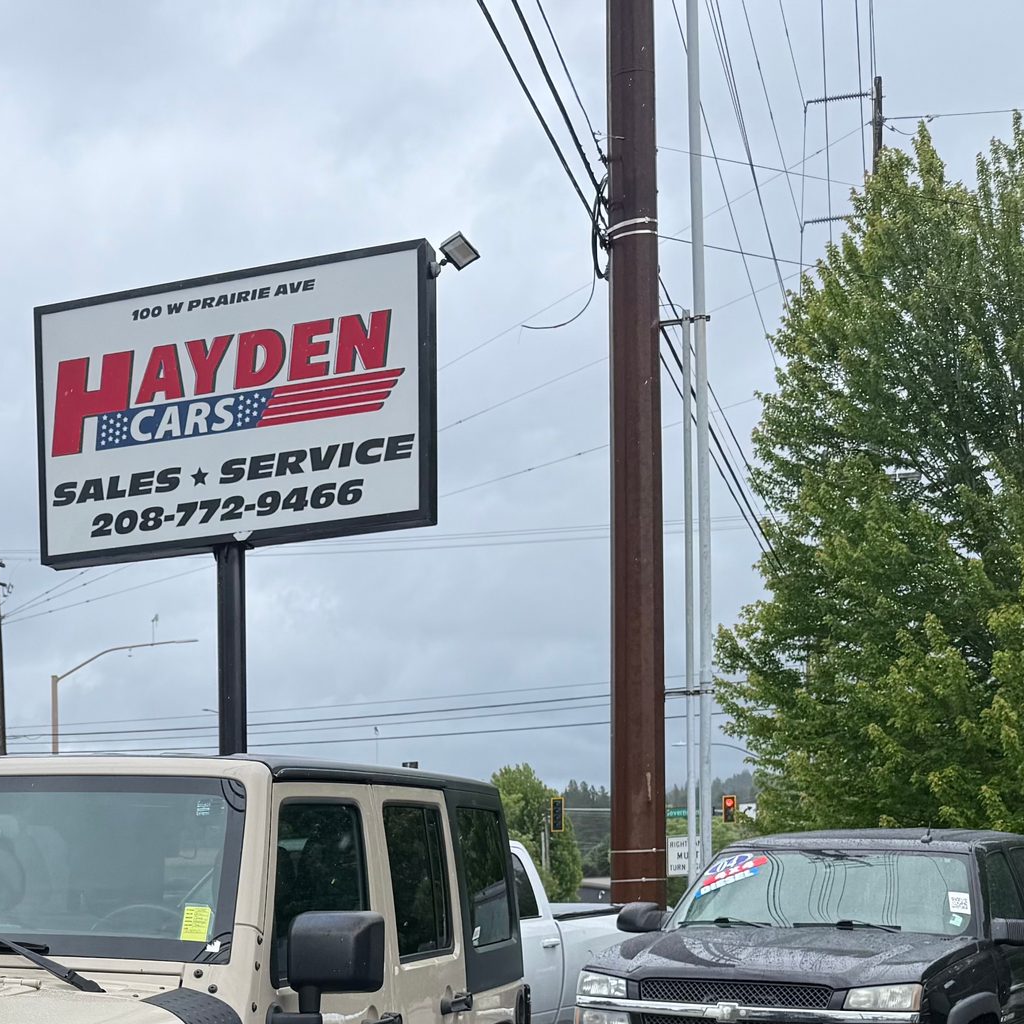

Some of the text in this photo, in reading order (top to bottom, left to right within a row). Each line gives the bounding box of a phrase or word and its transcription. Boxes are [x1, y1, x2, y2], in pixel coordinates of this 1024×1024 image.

[132, 279, 316, 321] 100 W PRAIRIE AVE
[52, 308, 392, 457] HAYDEN
[130, 397, 235, 443] CARS
[52, 433, 416, 507] SALES SERVICE
[90, 478, 365, 538] 208-772-9466
[669, 840, 687, 848] RIGHT
[700, 869, 754, 895] DIESEL
